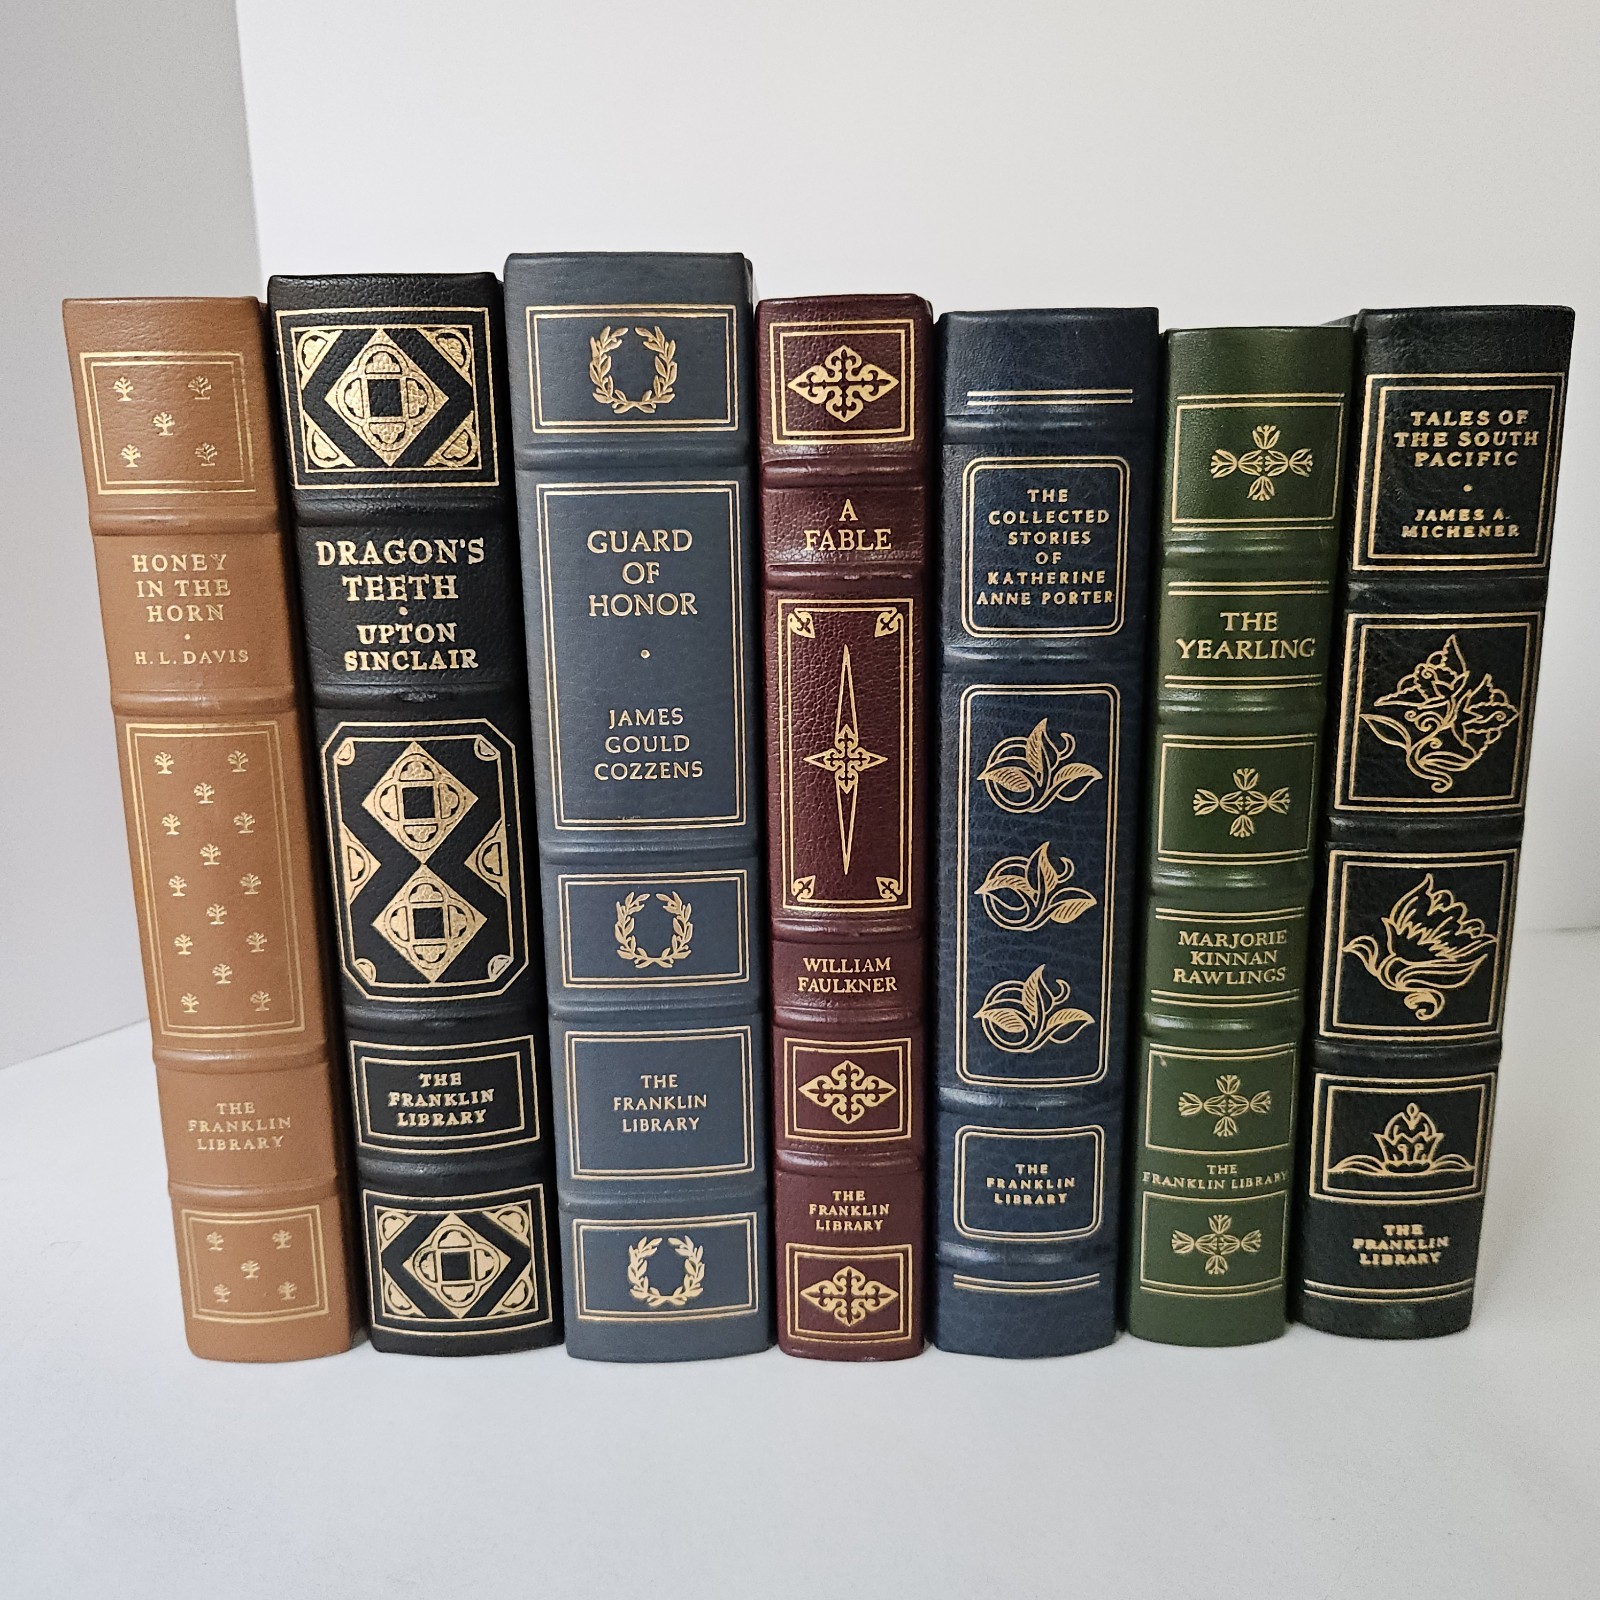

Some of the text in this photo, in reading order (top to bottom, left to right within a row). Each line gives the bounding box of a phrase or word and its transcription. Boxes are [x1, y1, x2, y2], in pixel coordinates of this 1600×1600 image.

[1411, 410, 1528, 426] TALES OF
[1394, 431, 1539, 448] THE SOUTH
[1415, 451, 1518, 467] PACIFIC
[1027, 489, 1067, 502] THE
[839, 499, 858, 521] A
[989, 510, 1109, 524] COLLECTED
[1415, 508, 1511, 521] JAMES A.
[1008, 531, 1090, 545] STORIES
[1401, 525, 1519, 538] MICHENER
[587, 530, 692, 553] GUARD
[802, 529, 891, 551] FABLE
[315, 537, 484, 565] DRAGON'S
[1036, 552, 1061, 564] OF
[132, 554, 226, 572] HONEY
[623, 562, 659, 584] OF
[988, 571, 1105, 584] KATHERINE
[136, 579, 230, 597] IN THE
[342, 574, 458, 601] TEETH
[589, 593, 697, 616] HONOR
[976, 590, 1113, 605] ANNE PORTER
[146, 604, 223, 622] HORN
[1220, 612, 1277, 631] THE
[357, 623, 457, 644] UPTON
[1175, 637, 1317, 660] YEARLING
[135, 650, 248, 665] H. L. DAVIS
[344, 649, 478, 671] SINCLAIR
[609, 708, 683, 729] JAMES
[605, 735, 689, 753] GOULD
[595, 761, 702, 780] COZZENS
[1178, 930, 1286, 949] MARJORIE
[803, 957, 890, 973] WILLIAM
[1191, 950, 1277, 965] KINNAN
[1173, 967, 1286, 984] RAWLINGS
[798, 977, 897, 993] FAULKNER
[419, 1072, 461, 1087] THE
[641, 1075, 678, 1088] THE
[388, 1089, 494, 1107] FRANKLIN
[614, 1095, 706, 1110] FRANKLIN
[217, 1102, 255, 1114] THE
[188, 1117, 290, 1132] FRANKLIN
[398, 1109, 486, 1126] LIBRARY
[623, 1117, 699, 1132] LIBRARY
[197, 1136, 283, 1150] LIBRARY
[1015, 1164, 1048, 1175] THE
[1207, 1165, 1237, 1174] THE
[987, 1178, 1074, 1189] FRANKLIN
[1142, 1170, 1289, 1189] FRANKLIN LIBRARY
[833, 1191, 865, 1201] THE
[995, 1193, 1067, 1204] LIBRARY
[809, 1204, 889, 1216] FRANKLIN
[816, 1220, 883, 1231] LIBRARY
[1383, 1224, 1423, 1236] THE
[1352, 1236, 1448, 1250] FRANKLIN
[1360, 1252, 1441, 1265] LIBRARY
